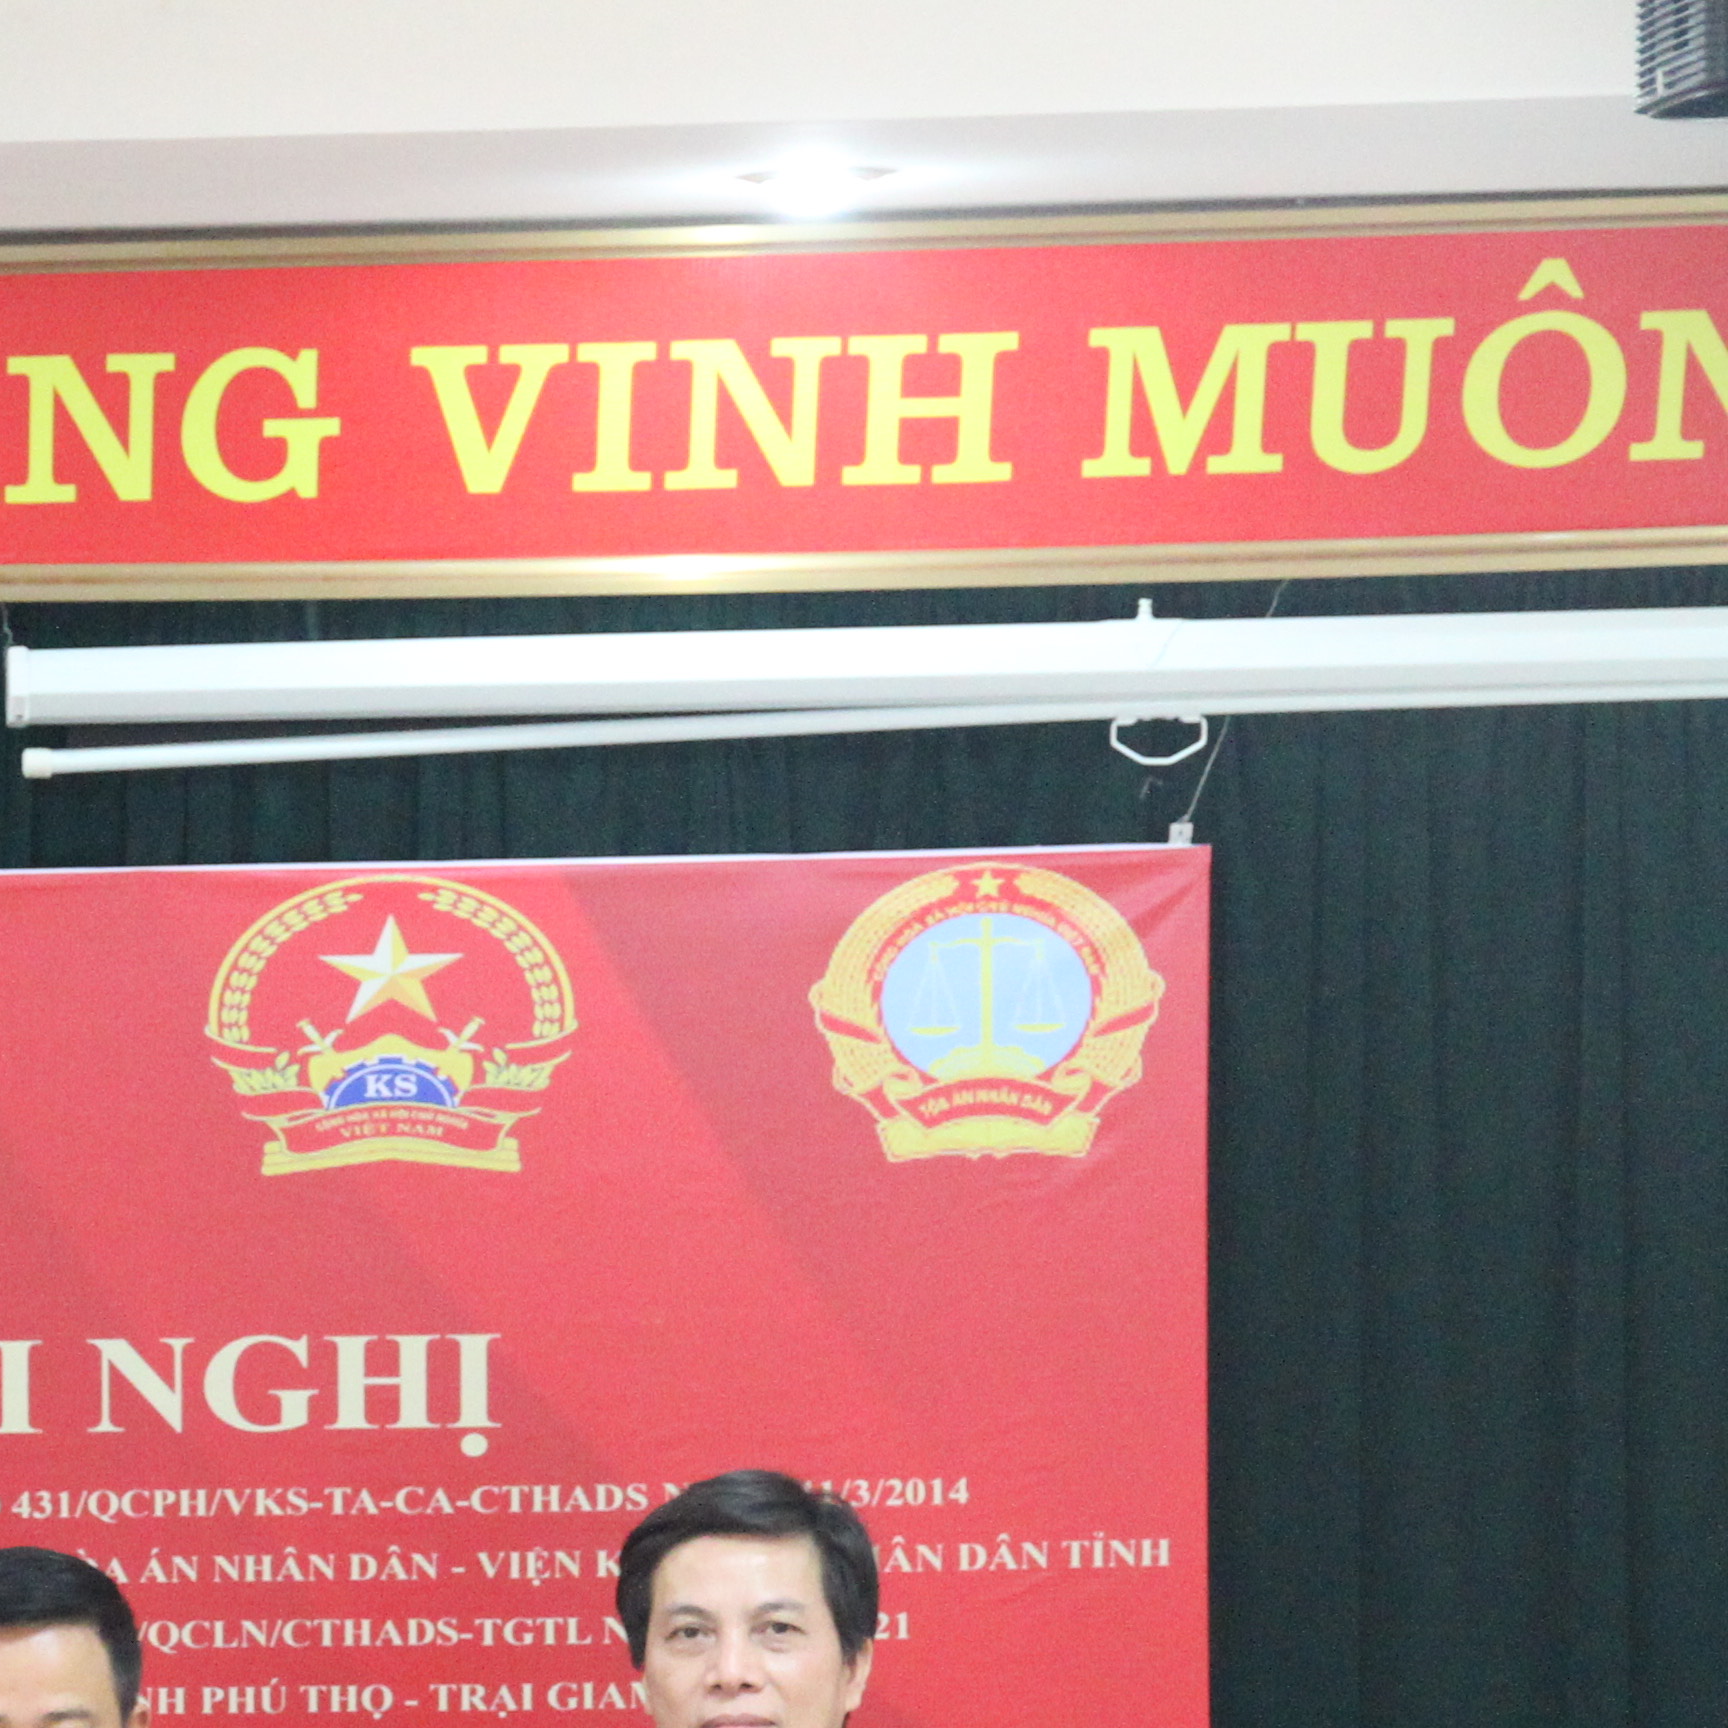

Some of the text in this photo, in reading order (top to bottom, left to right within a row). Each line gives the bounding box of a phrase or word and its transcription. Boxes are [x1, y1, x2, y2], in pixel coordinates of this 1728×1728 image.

[409, 330, 1020, 495] VINH
[364, 1072, 419, 1100] KS
[87, 1334, 501, 1457] NGHỊ
[12, 1484, 648, 1523] 431/QCPH/VKS-TA-CA-CTHADS
[140, 1548, 197, 1583] ÁN
[214, 1547, 334, 1582] NHÂN
[350, 1545, 437, 1580] DÂN
[478, 1547, 580, 1586] VIỆN
[959, 1533, 1047, 1571] DÂN
[1062, 1532, 1169, 1568] TỈNH
[138, 1616, 592, 1654] /QCLN/CTHADS-TGTL
[202, 1678, 286, 1714] PHÚ
[300, 1685, 393, 1719] THỌ
[430, 1683, 532, 1718] TRẠI
